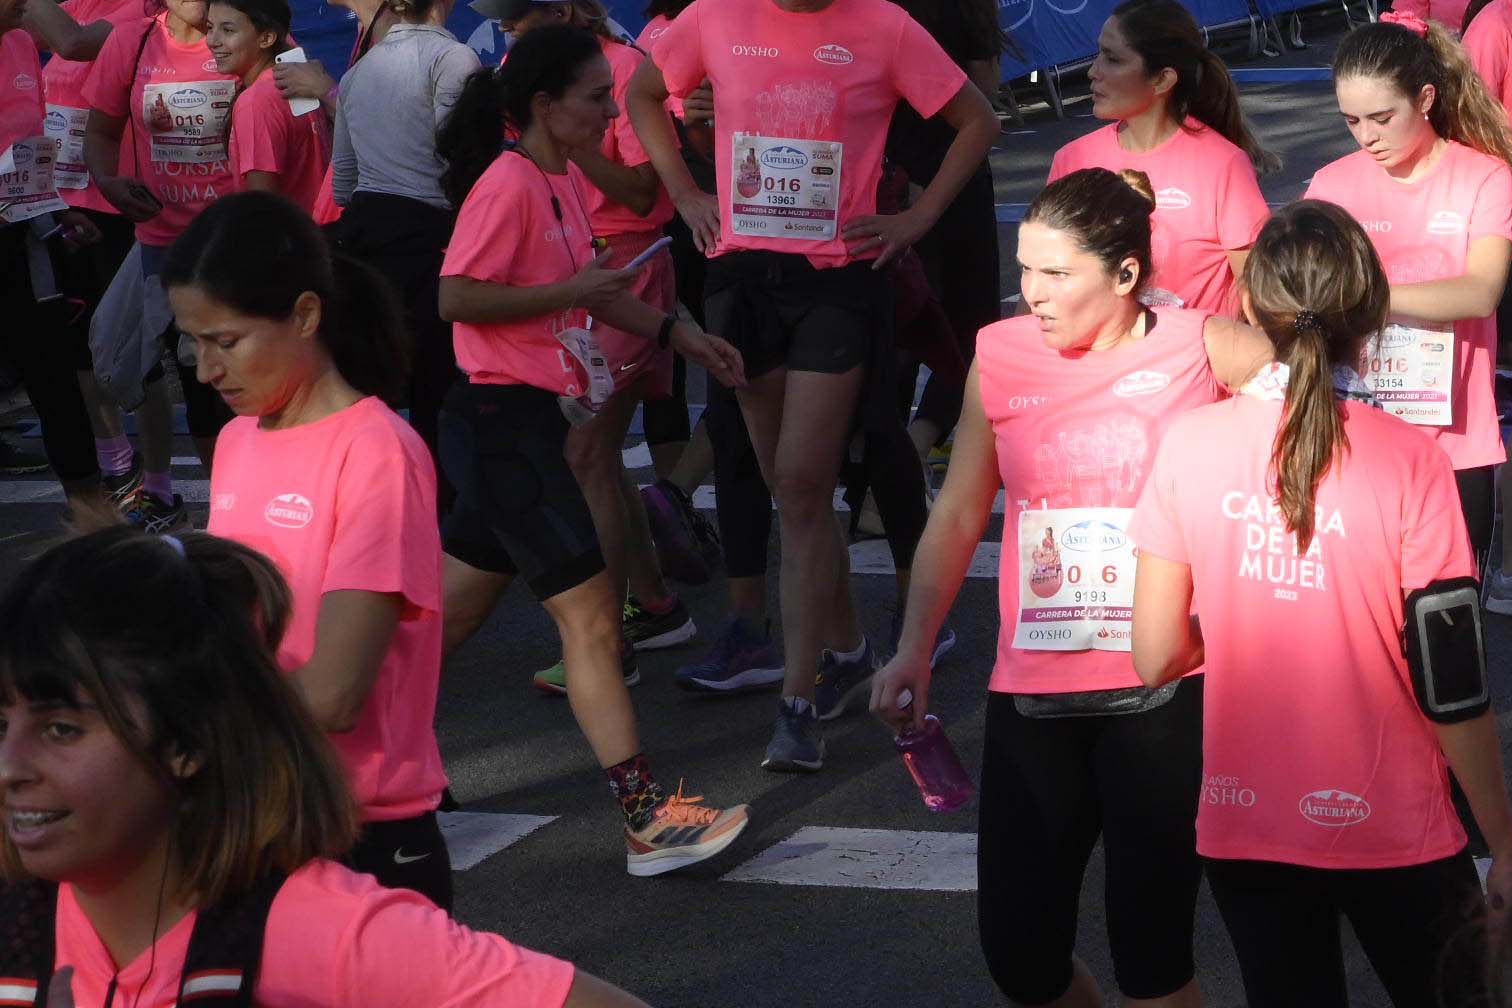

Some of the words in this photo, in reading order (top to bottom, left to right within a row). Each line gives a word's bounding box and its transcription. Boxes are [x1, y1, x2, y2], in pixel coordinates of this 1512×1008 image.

[732, 45, 778, 58] OYSHO
[175, 114, 204, 127] 016
[763, 153, 806, 166] ASTURIANA
[763, 176, 801, 193] 016
[766, 195, 796, 205] 13963
[1364, 220, 1392, 234] SHO
[1246, 524, 1283, 555] DE
[1067, 565, 1118, 584] 06
[1238, 552, 1326, 591] MUJER
[1035, 610, 1073, 620] CARRERA
[1073, 609, 1086, 618] DE
[1087, 609, 1099, 617] LA
[1100, 609, 1133, 618] MUJER
[1028, 629, 1072, 641] OYSHO
[1303, 799, 1365, 819] ASTURIANA
